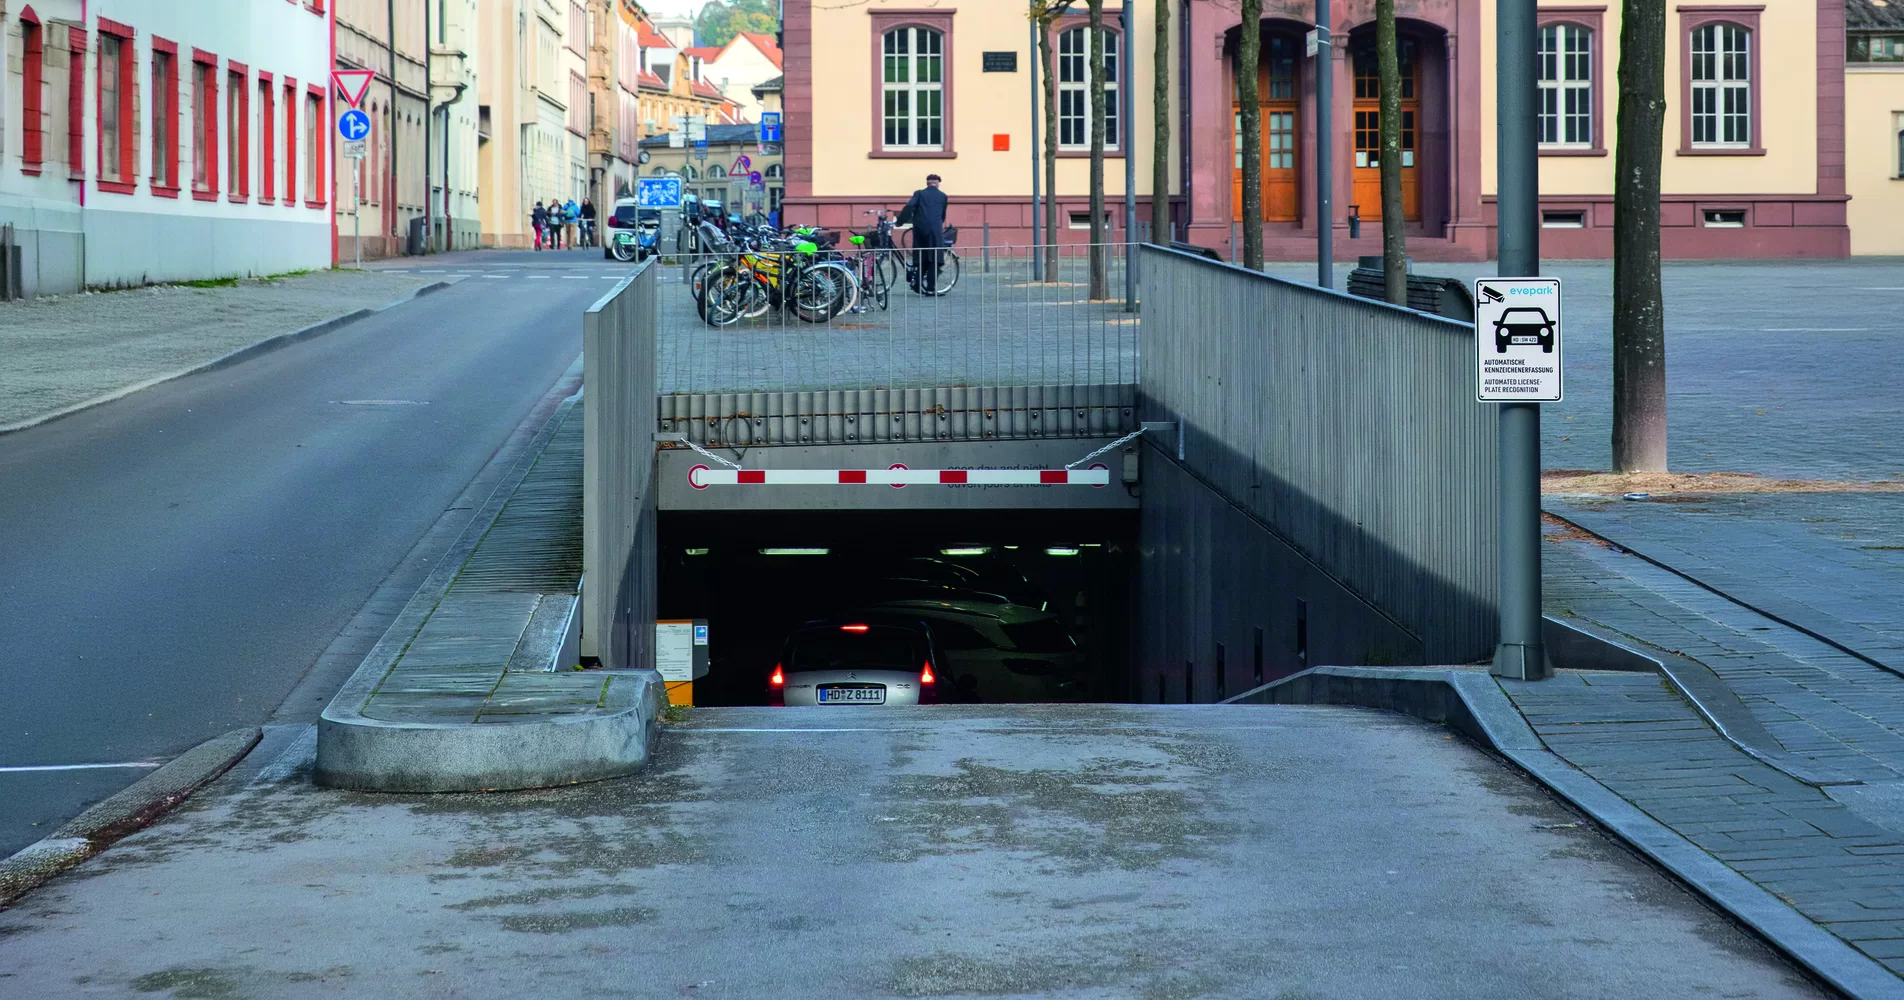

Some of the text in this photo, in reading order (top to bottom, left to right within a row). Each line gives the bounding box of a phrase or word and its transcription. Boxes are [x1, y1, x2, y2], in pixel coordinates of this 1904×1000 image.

[1510, 286, 1553, 296] evopark
[826, 689, 880, 700] HD Z 8111
